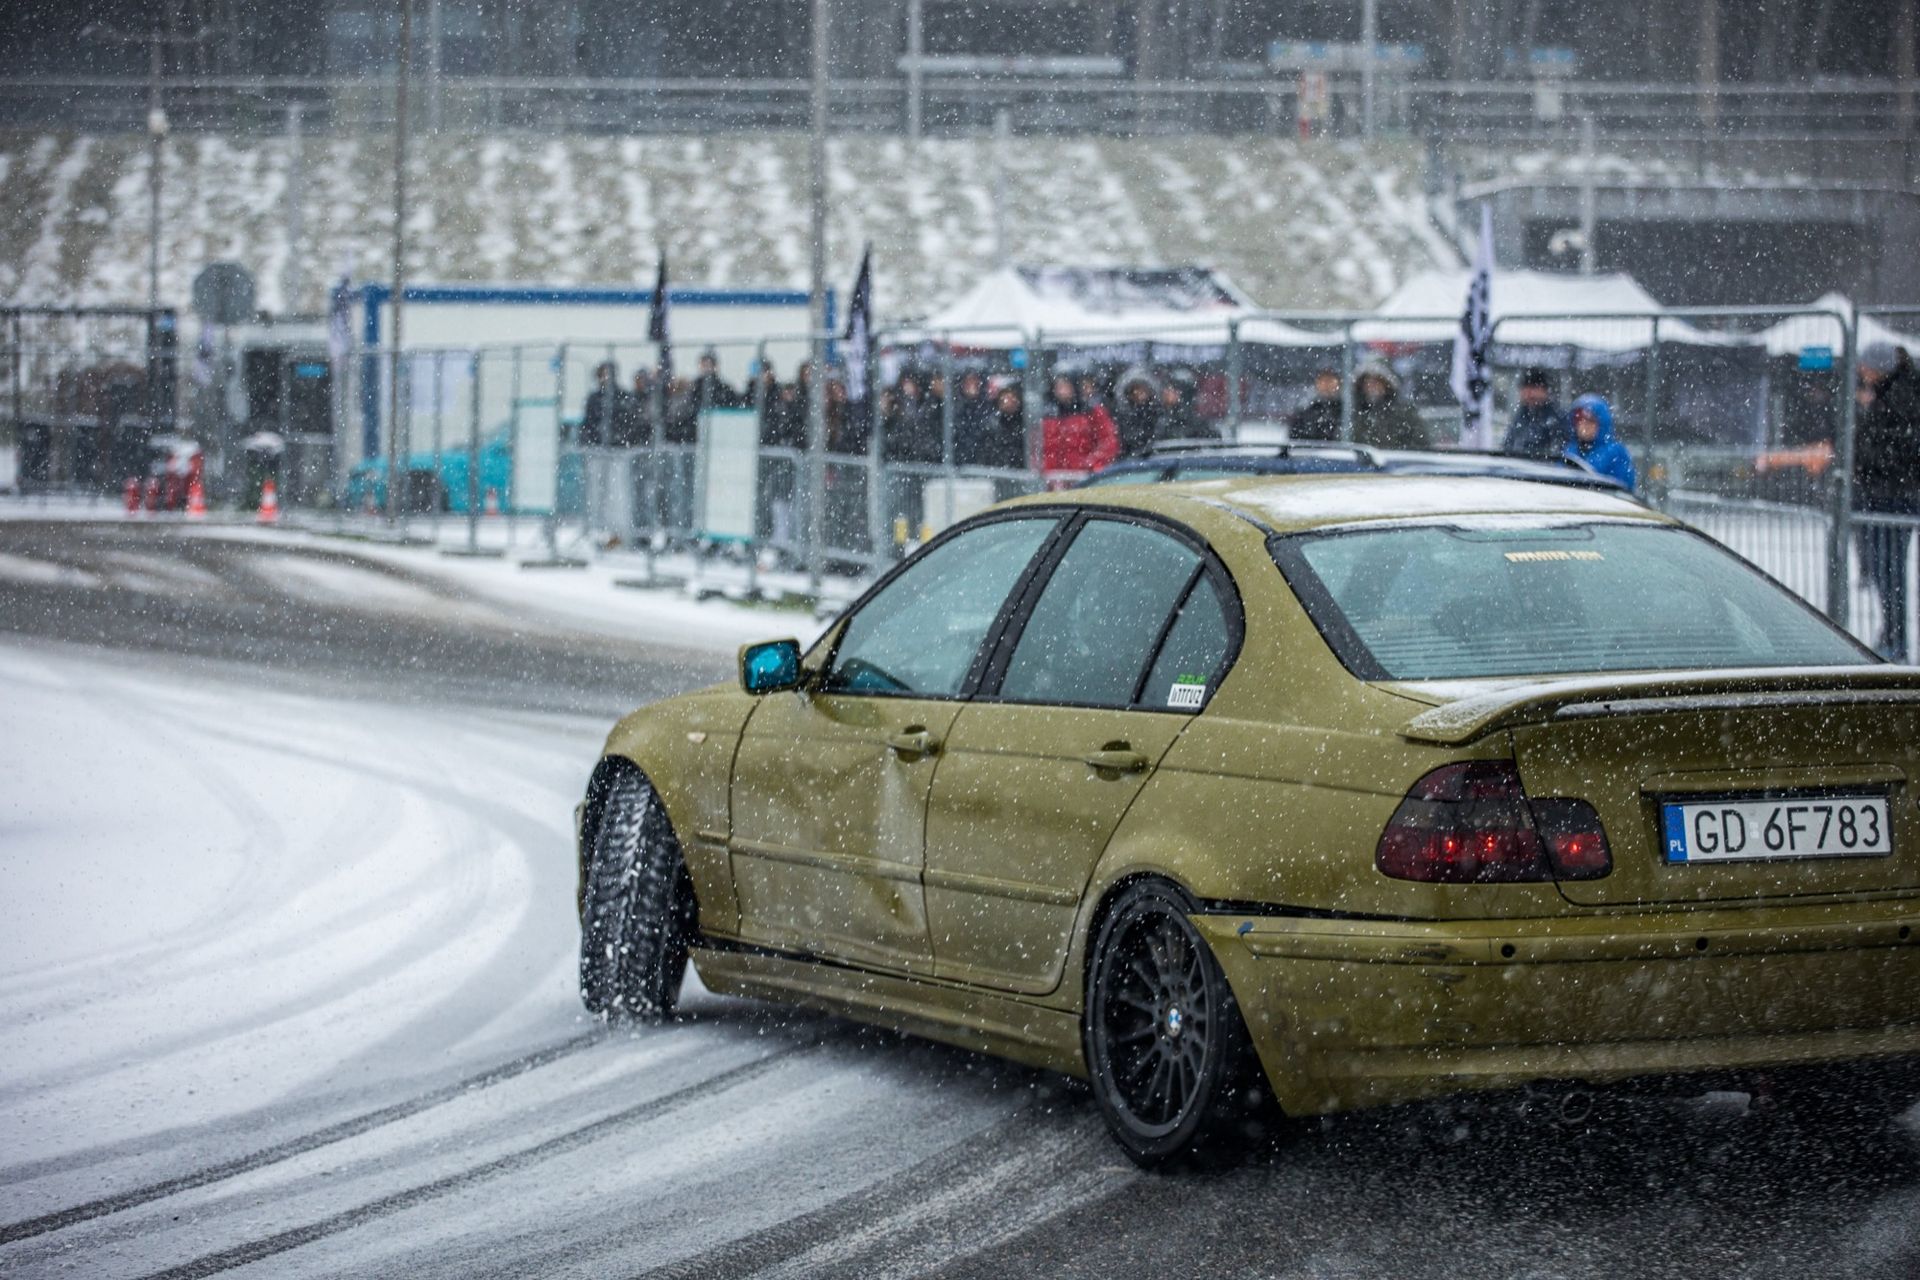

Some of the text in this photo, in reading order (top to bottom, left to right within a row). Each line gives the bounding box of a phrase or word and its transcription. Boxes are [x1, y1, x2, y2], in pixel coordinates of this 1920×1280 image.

[1694, 805, 1880, 853] GD 6F783
[1669, 839, 1684, 852] PL
